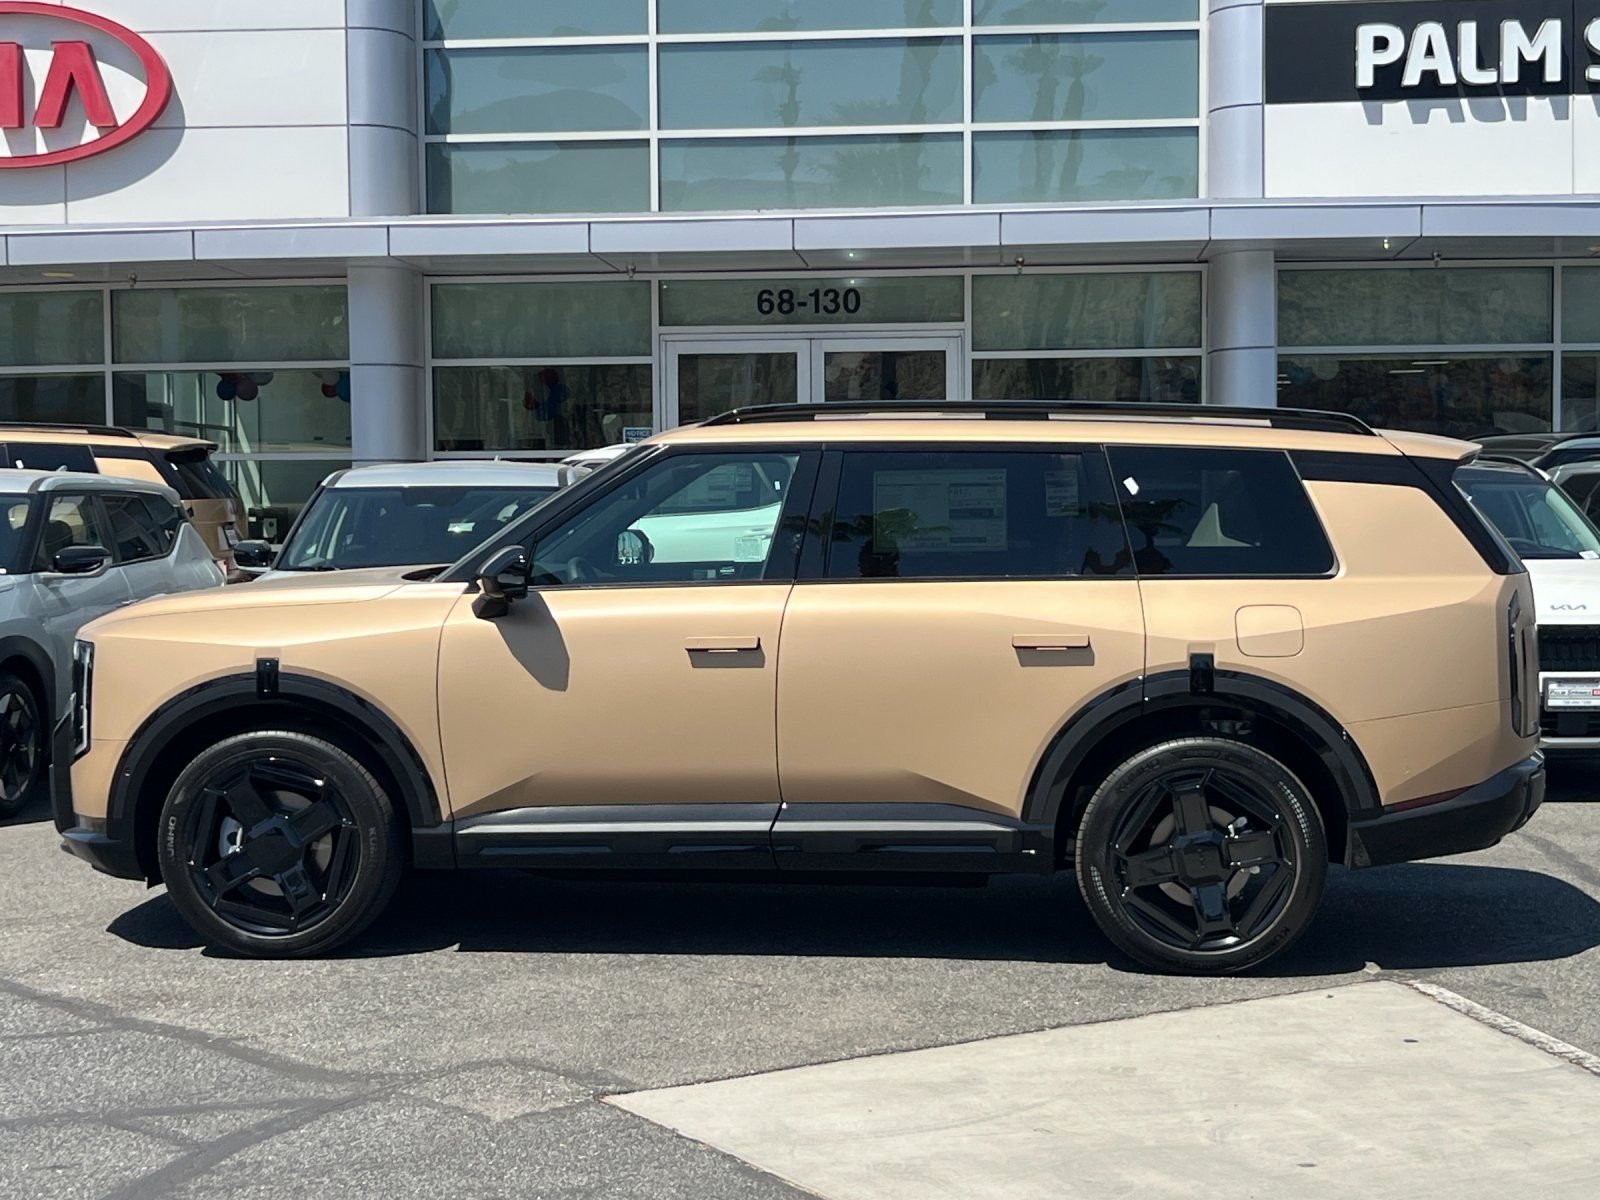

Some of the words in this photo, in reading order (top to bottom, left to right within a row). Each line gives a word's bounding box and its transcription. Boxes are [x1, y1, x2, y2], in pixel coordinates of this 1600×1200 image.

[1355, 18, 1562, 88] PALM
[757, 288, 861, 315] 68-130
[166, 815, 177, 862] UMHO
